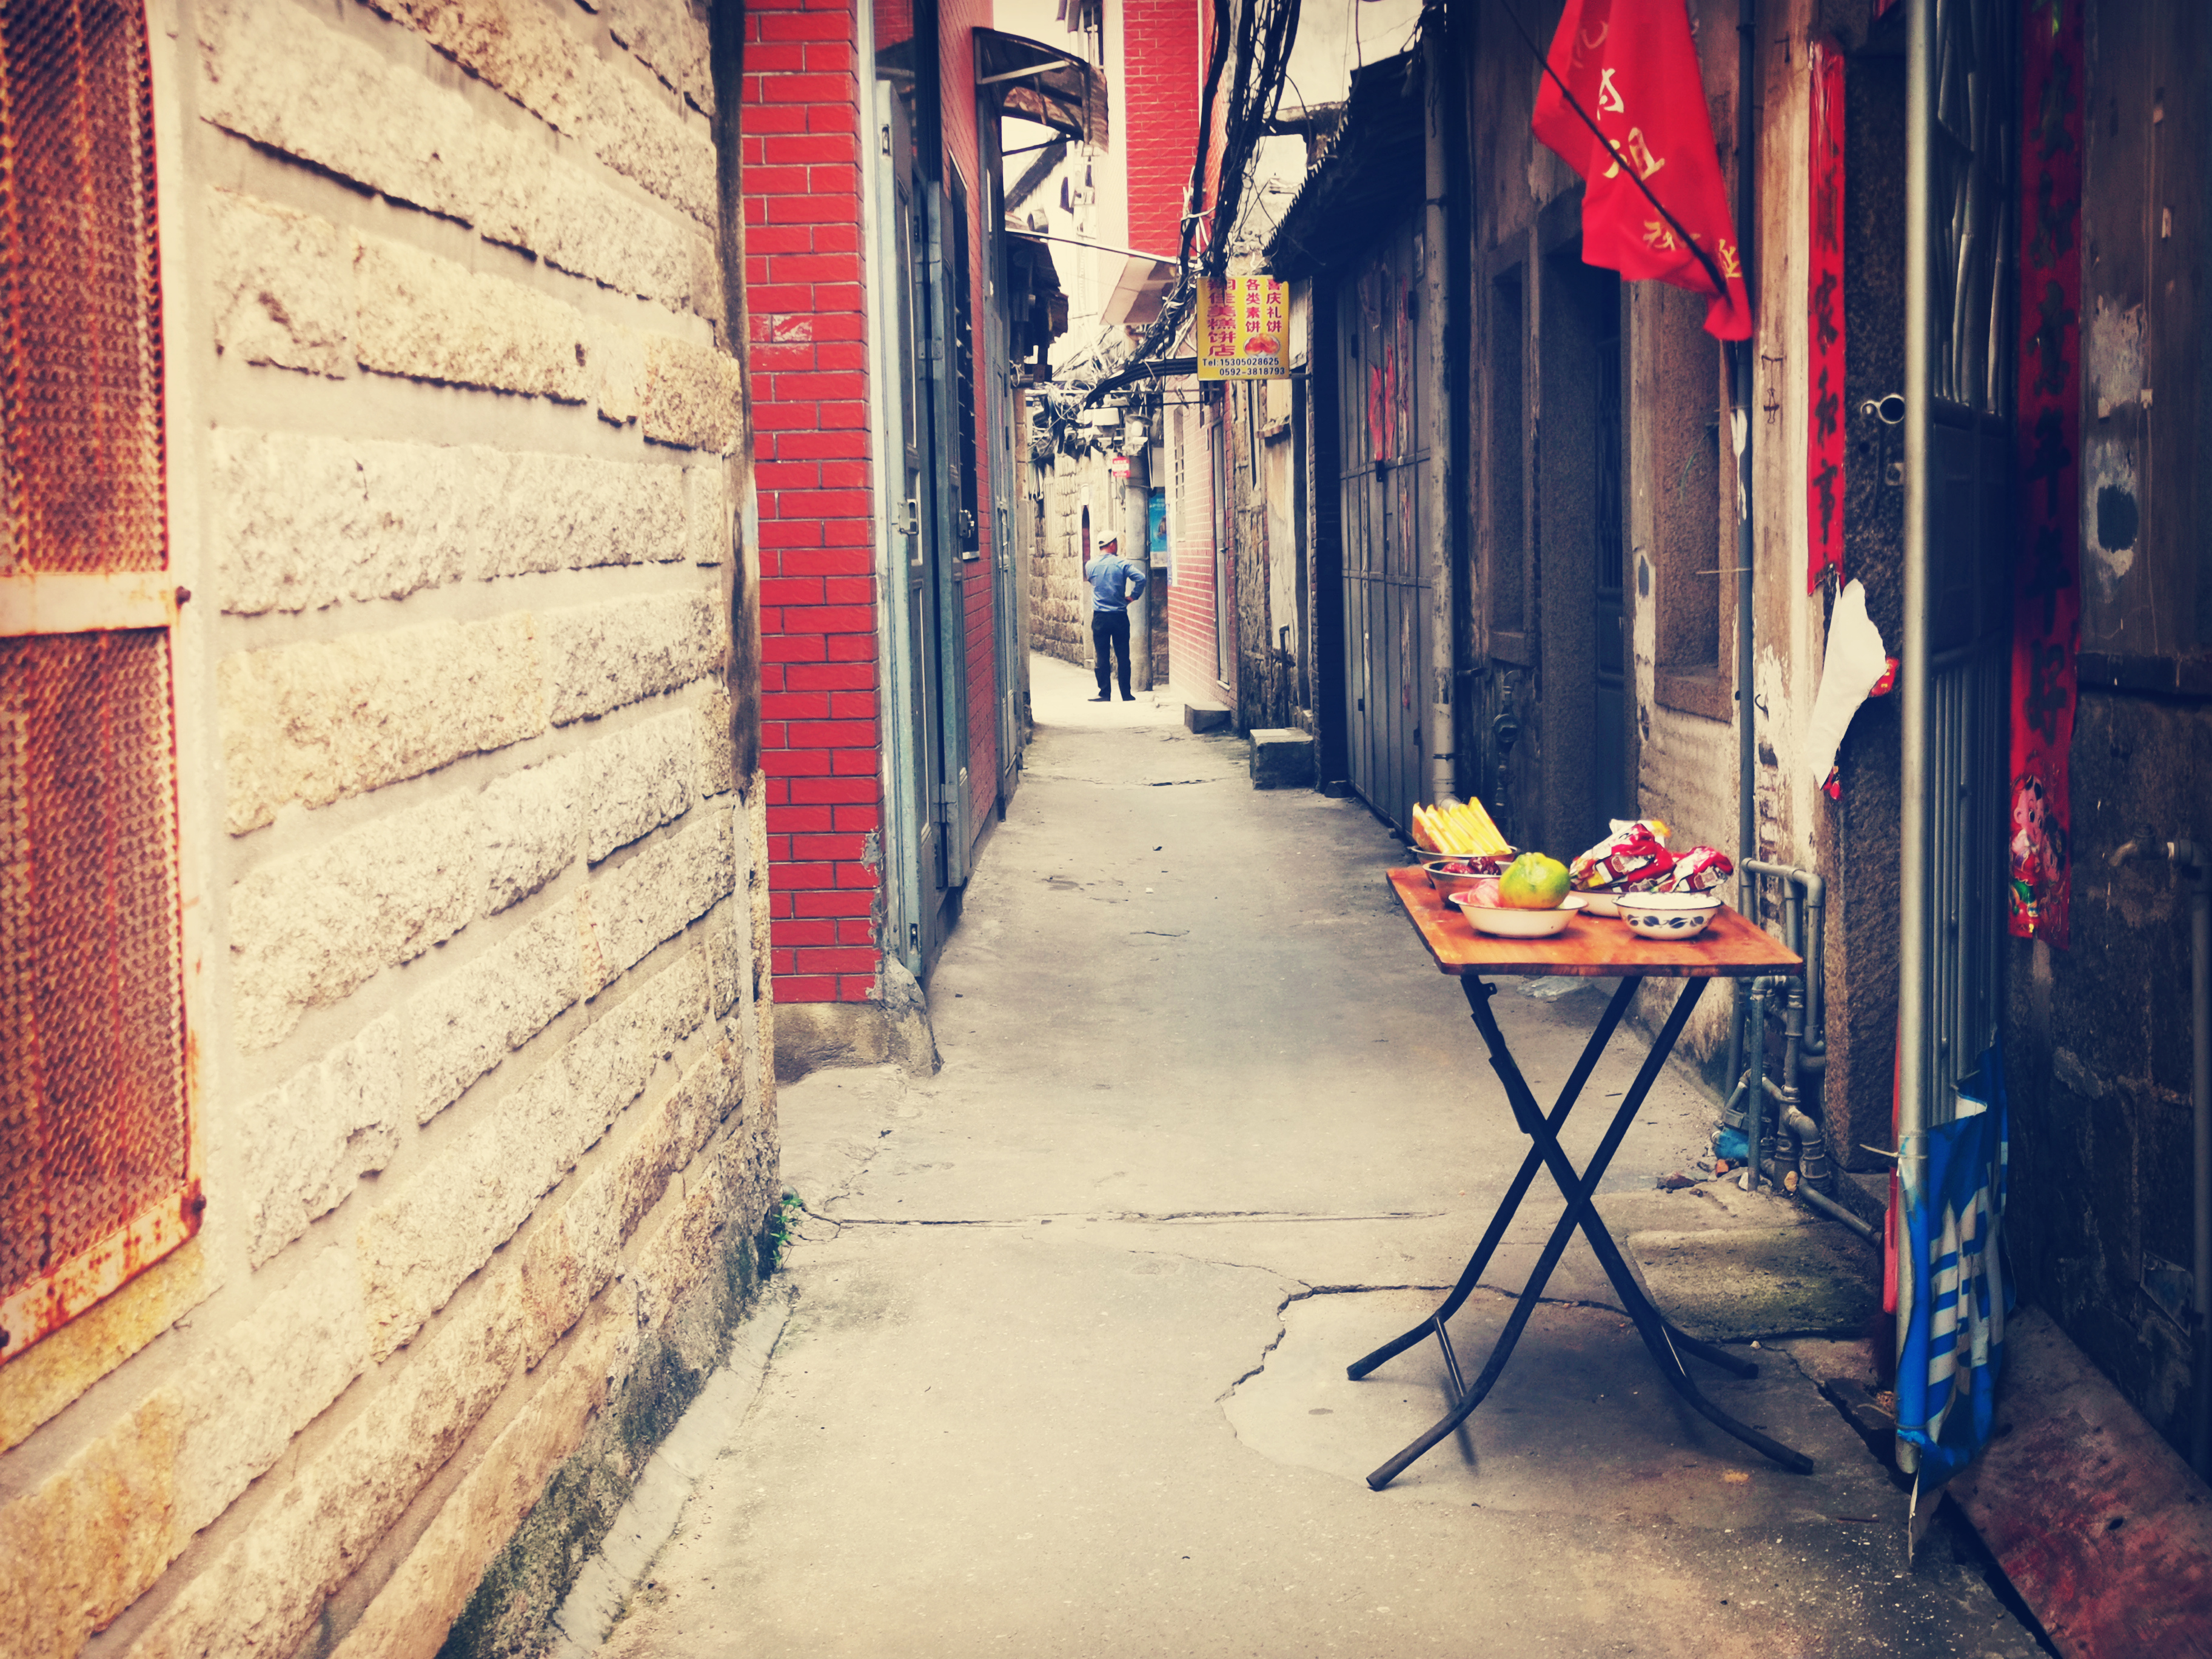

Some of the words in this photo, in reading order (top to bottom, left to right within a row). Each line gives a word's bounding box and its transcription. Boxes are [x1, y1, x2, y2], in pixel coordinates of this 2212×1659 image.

[1245, 278, 1261, 333] 各类素饼
[1202, 357, 1279, 366] Tel:15305028625
[1219, 367, 1285, 375] 0592-3818793
